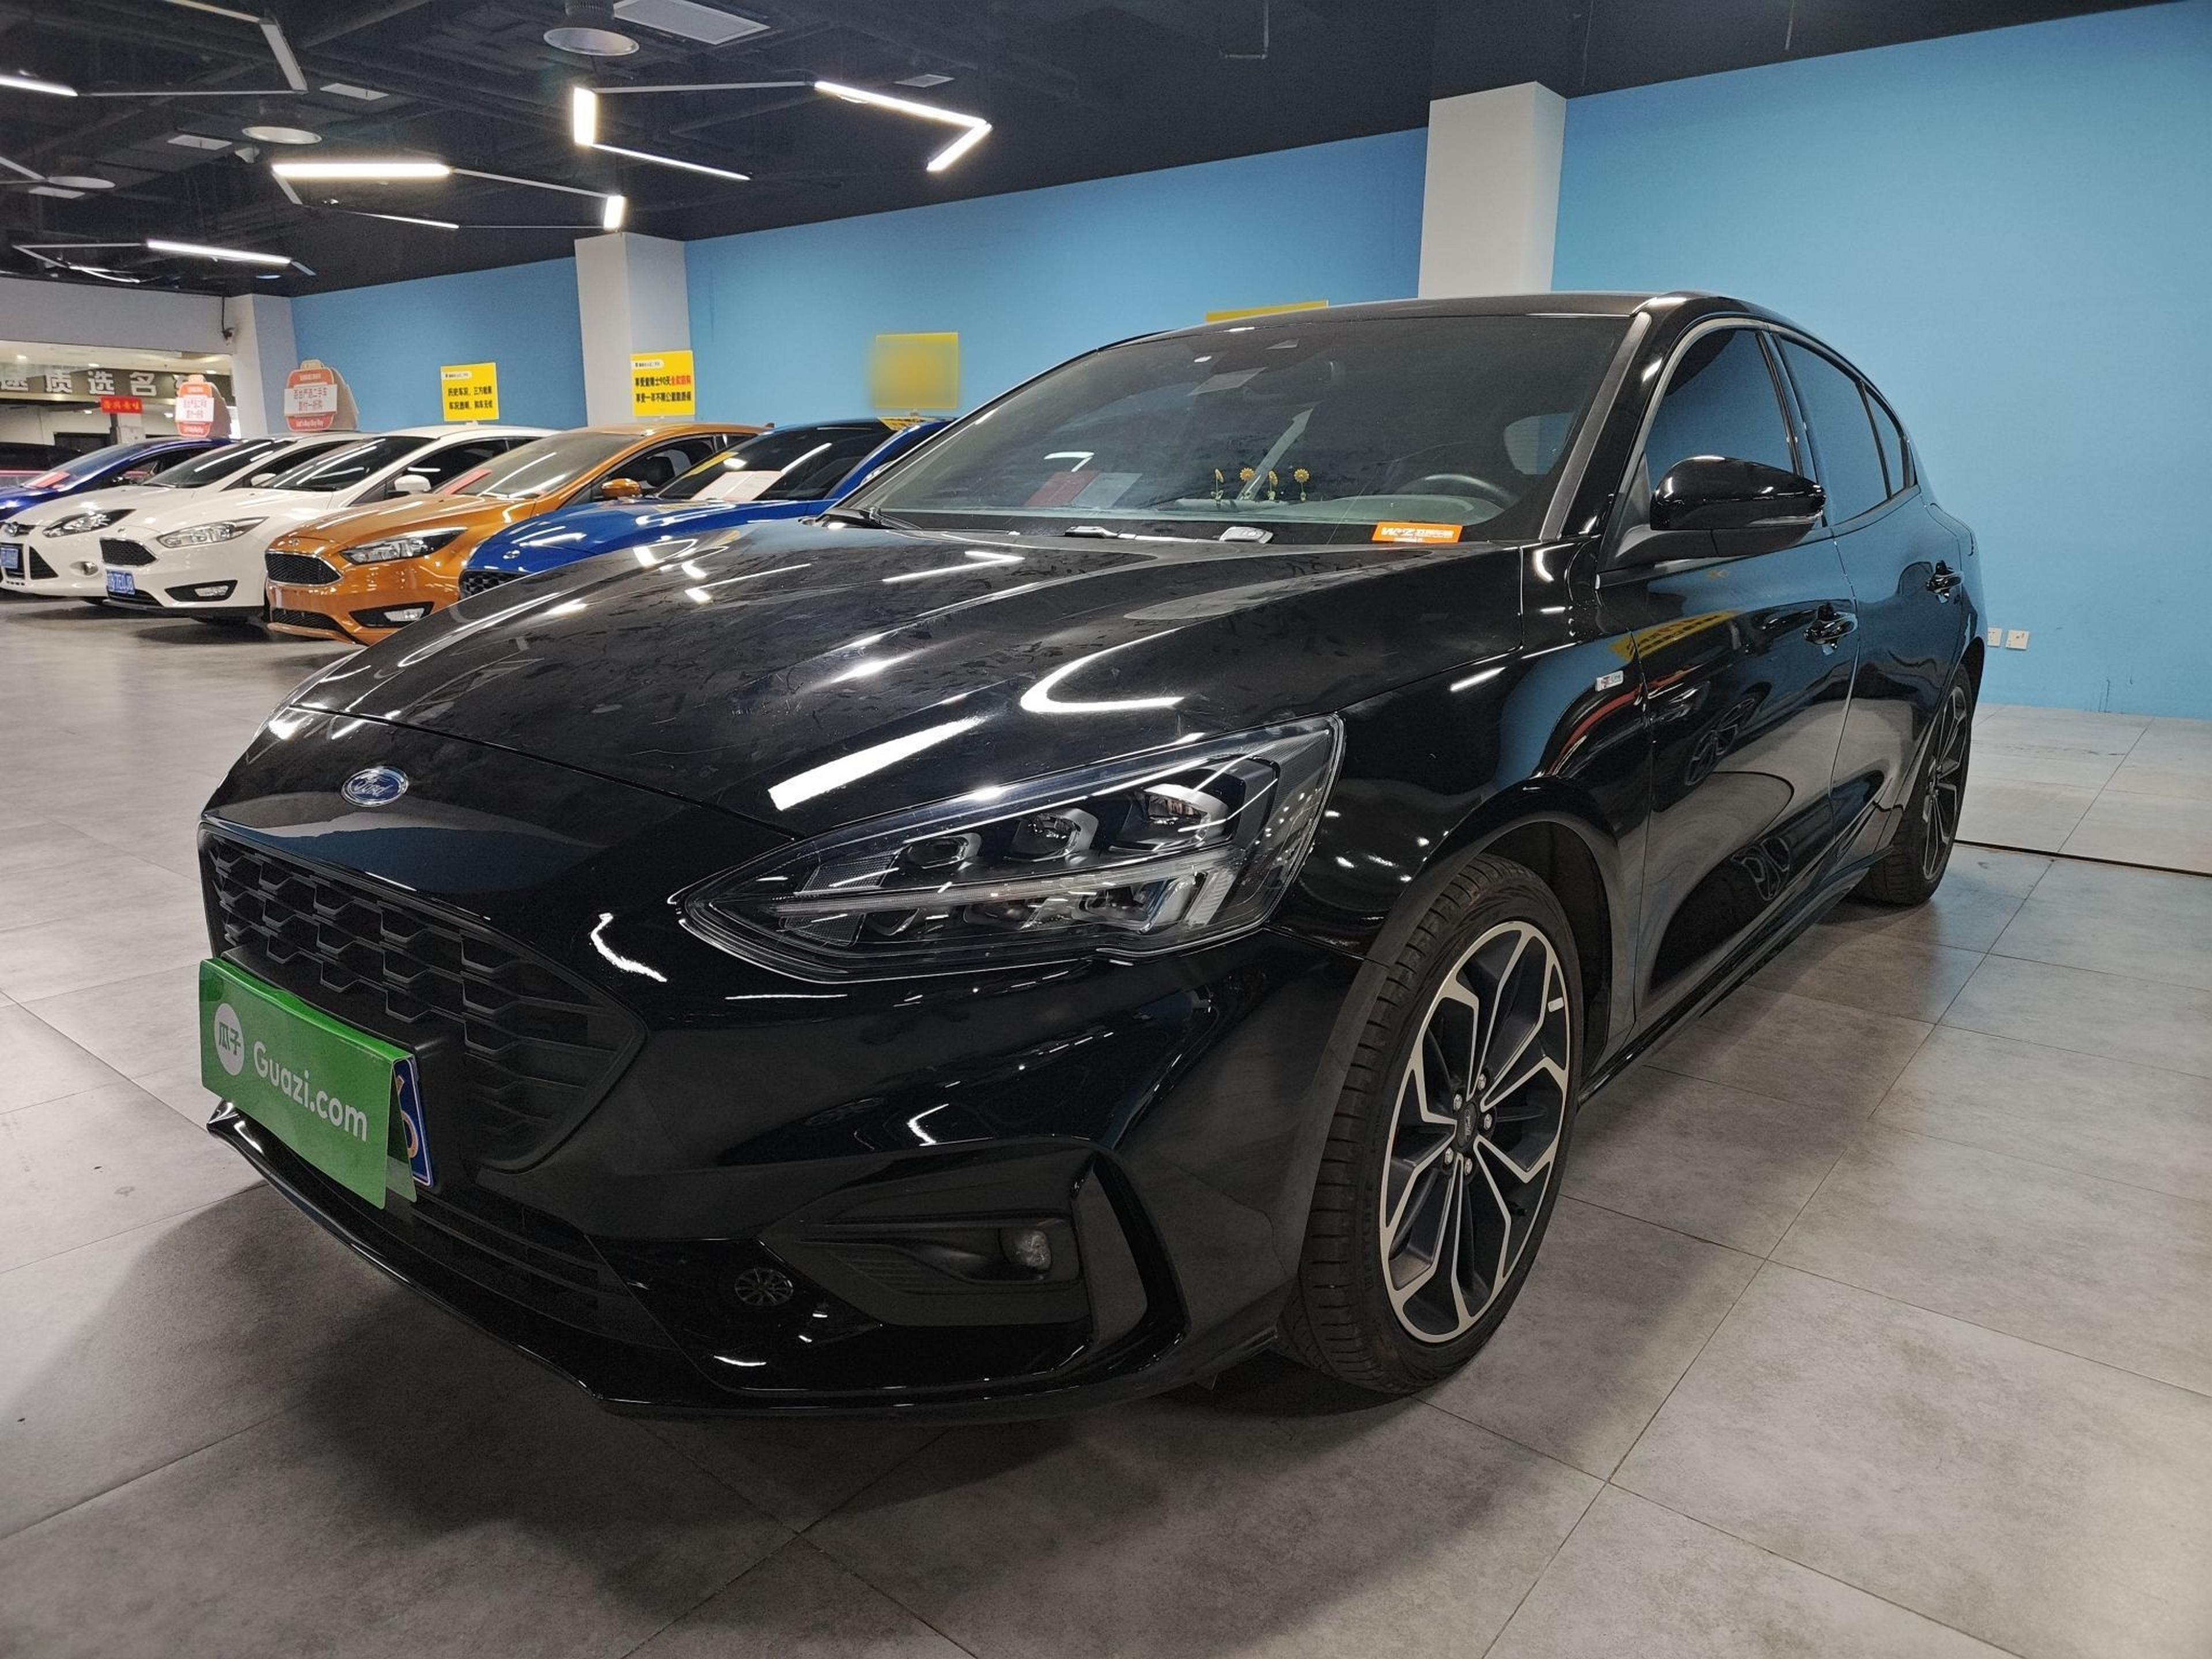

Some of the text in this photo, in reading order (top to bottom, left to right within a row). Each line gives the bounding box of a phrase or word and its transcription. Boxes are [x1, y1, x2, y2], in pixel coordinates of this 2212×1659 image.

[349, 775, 394, 798] Ford
[218, 1022, 242, 1056] 瓜子
[253, 1040, 368, 1142] Guazi.com
